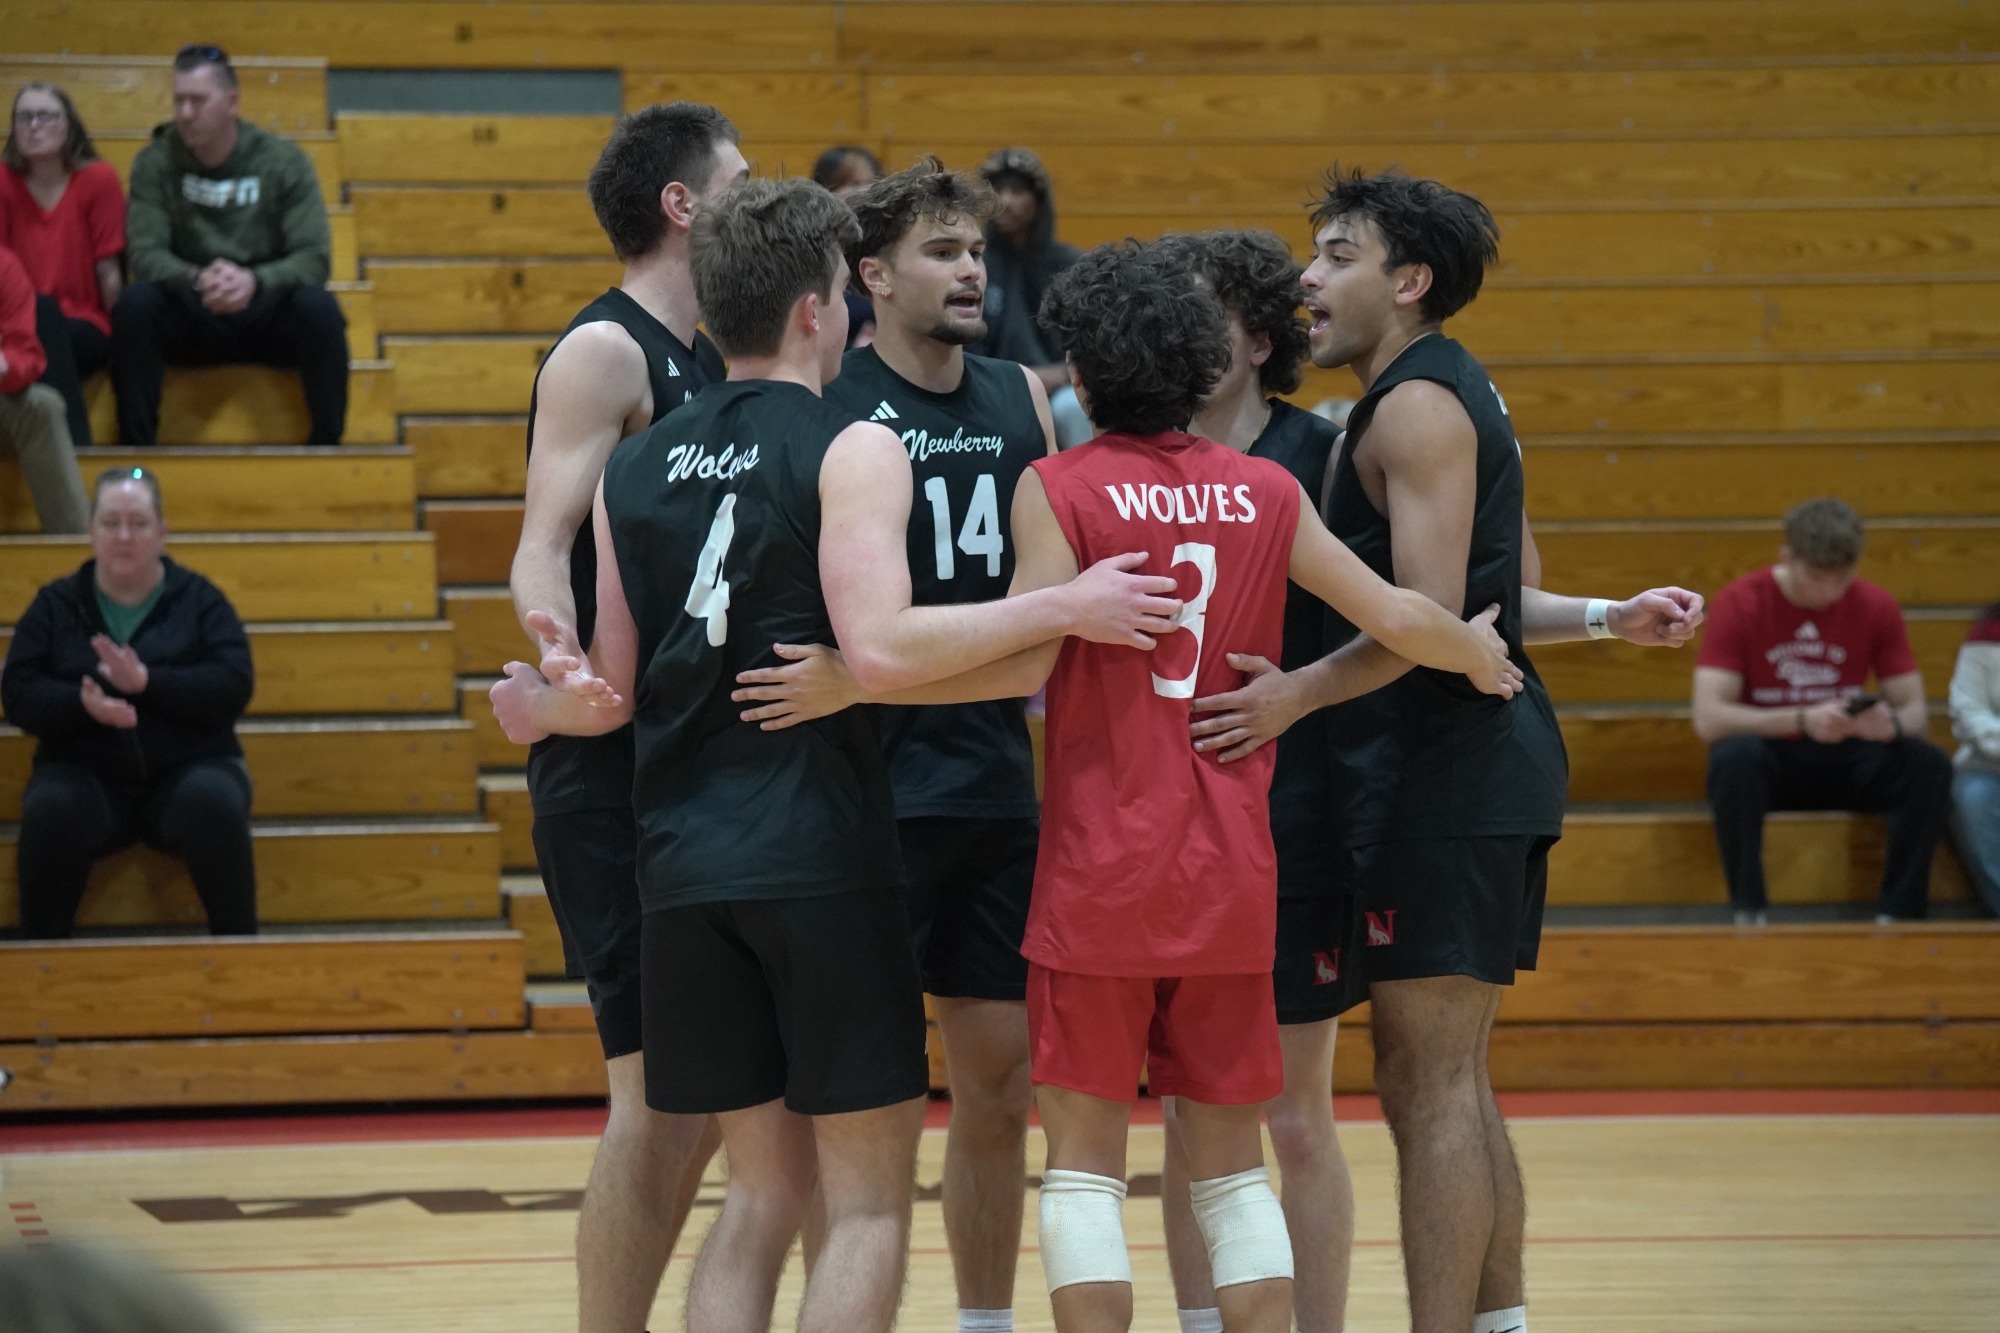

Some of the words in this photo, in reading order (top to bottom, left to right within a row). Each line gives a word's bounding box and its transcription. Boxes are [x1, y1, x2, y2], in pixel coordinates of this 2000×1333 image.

[901, 426, 1004, 462] Newberry
[924, 474, 1003, 580] 14
[1104, 483, 1257, 524] WOLVES
[684, 492, 737, 647] 4
[1151, 541, 1217, 699] 3
[1364, 910, 1398, 946] N
